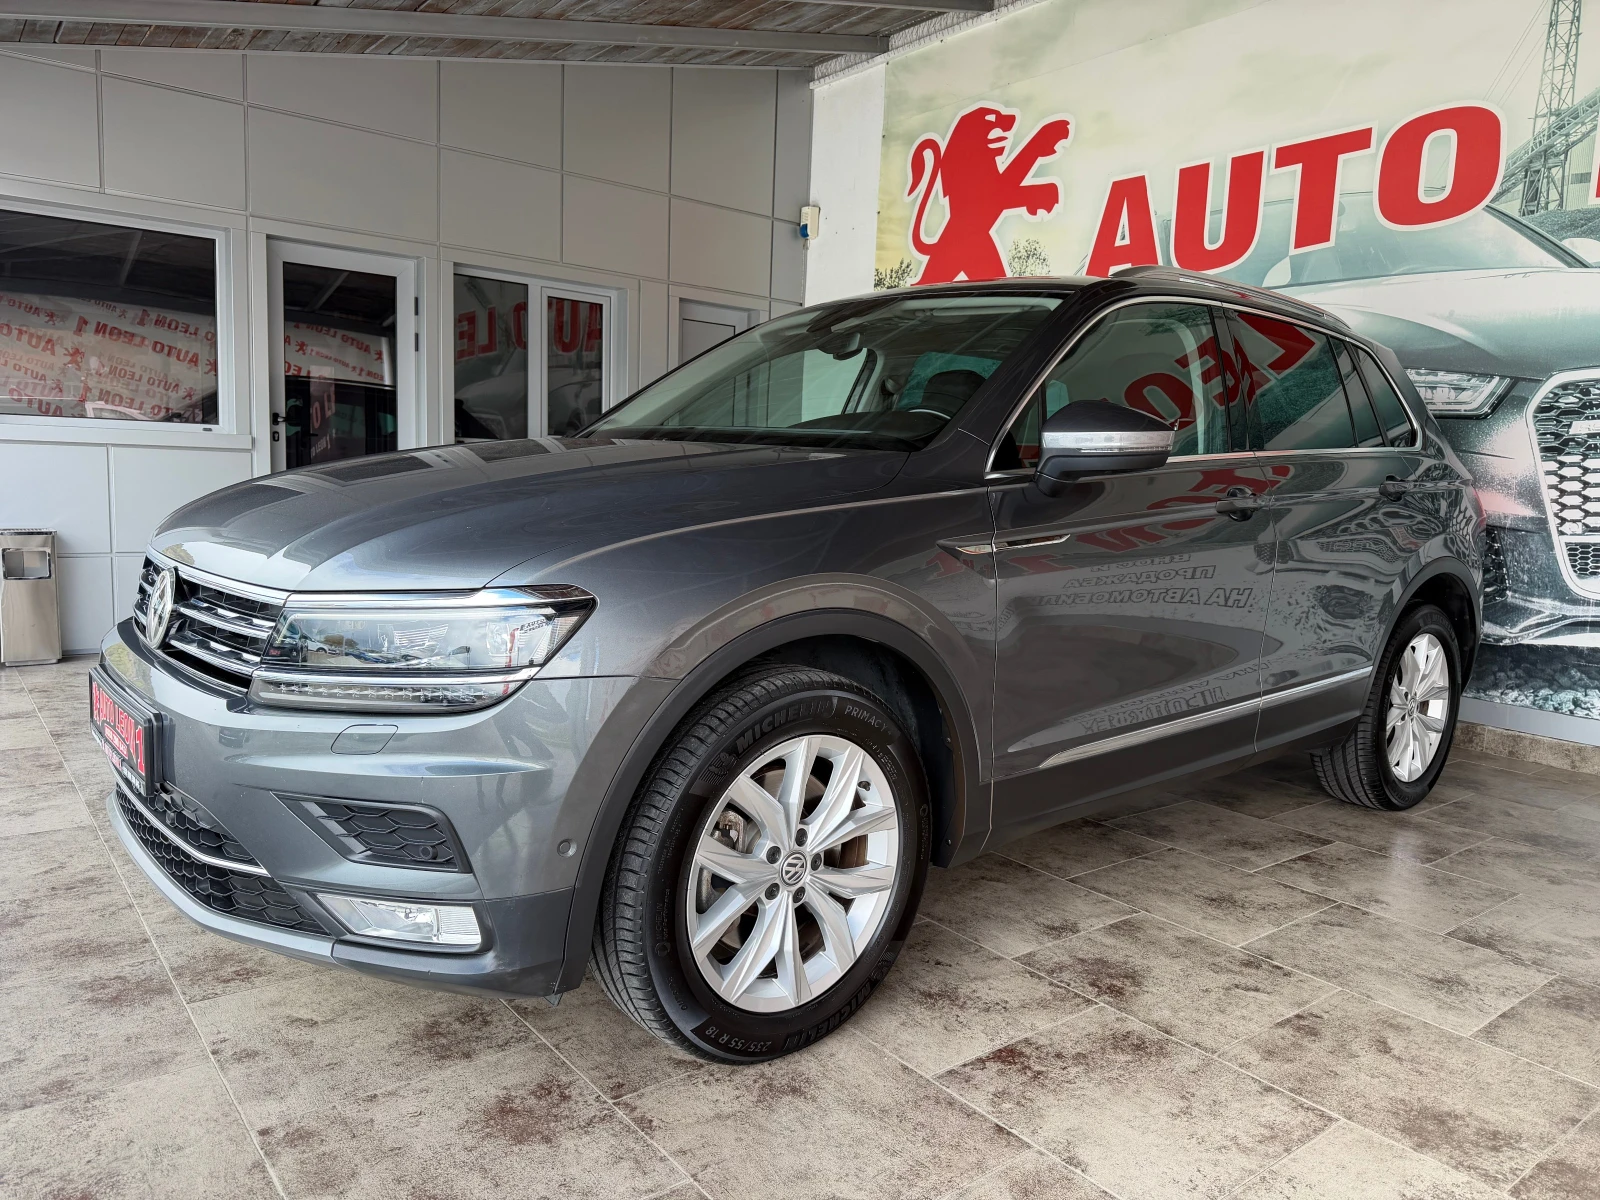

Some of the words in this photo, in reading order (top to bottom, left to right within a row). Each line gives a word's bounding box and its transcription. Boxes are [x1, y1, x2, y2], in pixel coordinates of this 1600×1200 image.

[1084, 104, 1502, 278] AUTO
[844, 704, 888, 732] PRIMACY
[135, 725, 146, 776] 1
[705, 1026, 721, 1038] 18
[719, 1034, 730, 1044] R
[728, 1038, 772, 1053] 235/55
